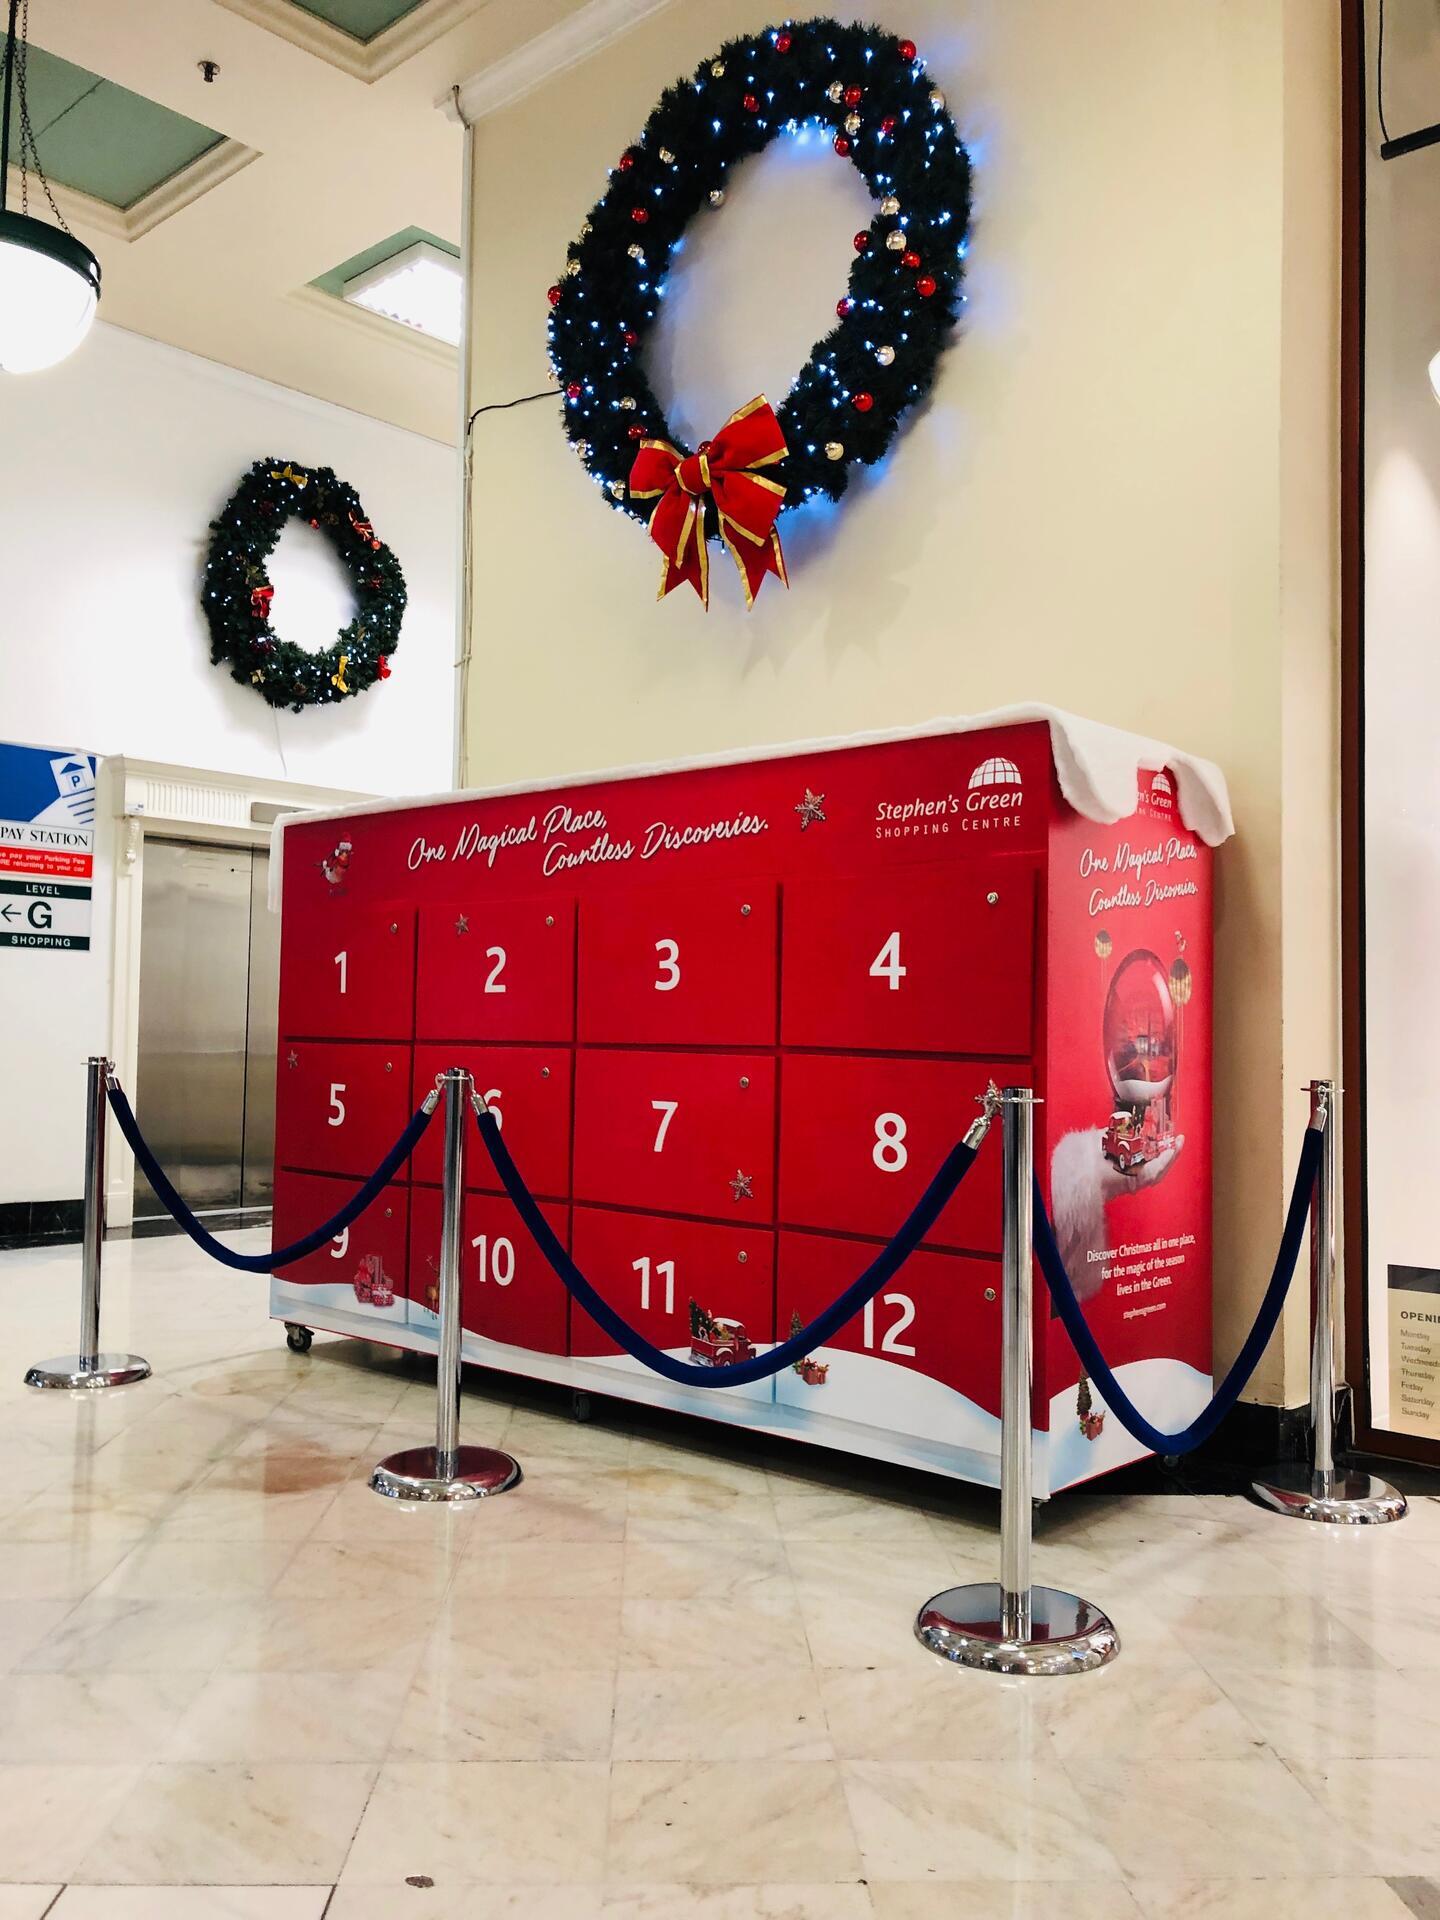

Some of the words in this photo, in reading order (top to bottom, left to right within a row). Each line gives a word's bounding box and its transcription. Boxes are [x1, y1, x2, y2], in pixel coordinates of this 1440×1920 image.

[875, 794, 959, 821] Stephen's
[966, 791, 1023, 811] Green
[0, 826, 24, 840] PAY
[30, 829, 88, 846] STATION
[408, 838, 446, 870] One
[451, 816, 537, 867] Magical
[543, 805, 607, 843] Place,
[543, 834, 635, 876] Countless
[640, 811, 769, 860] Discoveries.
[875, 823, 949, 839] SHOPPING
[961, 815, 1021, 831] CENTRE
[44, 855, 71, 865] Parking
[1080, 848, 1109, 878] One
[1113, 842, 1164, 881] Magical
[26, 884, 60, 896] LEVEL
[1088, 884, 1142, 916] Countless
[27, 901, 52, 929] G
[11, 935, 71, 947] SHOPPING
[869, 932, 907, 990] 4
[334, 951, 347, 994] 1
[484, 946, 507, 993] 2
[654, 938, 681, 991] 3
[328, 1083, 346, 1126] 5
[485, 1088, 503, 1131] 6
[651, 1100, 678, 1152] 7
[872, 1112, 908, 1172] 8
[330, 1226, 349, 1259] 9
[471, 1234, 515, 1286] 10
[1087, 1249, 1118, 1262] Discover
[1119, 1242, 1152, 1257] Christmas
[1153, 1238, 1161, 1251] all
[1161, 1237, 1168, 1249] in
[1168, 1237, 1179, 1248] one
[632, 1256, 675, 1314] 11
[1101, 1266, 1112, 1280] for
[1113, 1264, 1125, 1278] the
[1126, 1260, 1146, 1276] magic
[1146, 1258, 1155, 1271] of
[1154, 1256, 1165, 1269] the
[1165, 1254, 1185, 1267] season
[1116, 1283, 1132, 1296] lives
[1133, 1280, 1140, 1292] in
[1141, 1278, 1152, 1291] the
[862, 1293, 916, 1357] 12
